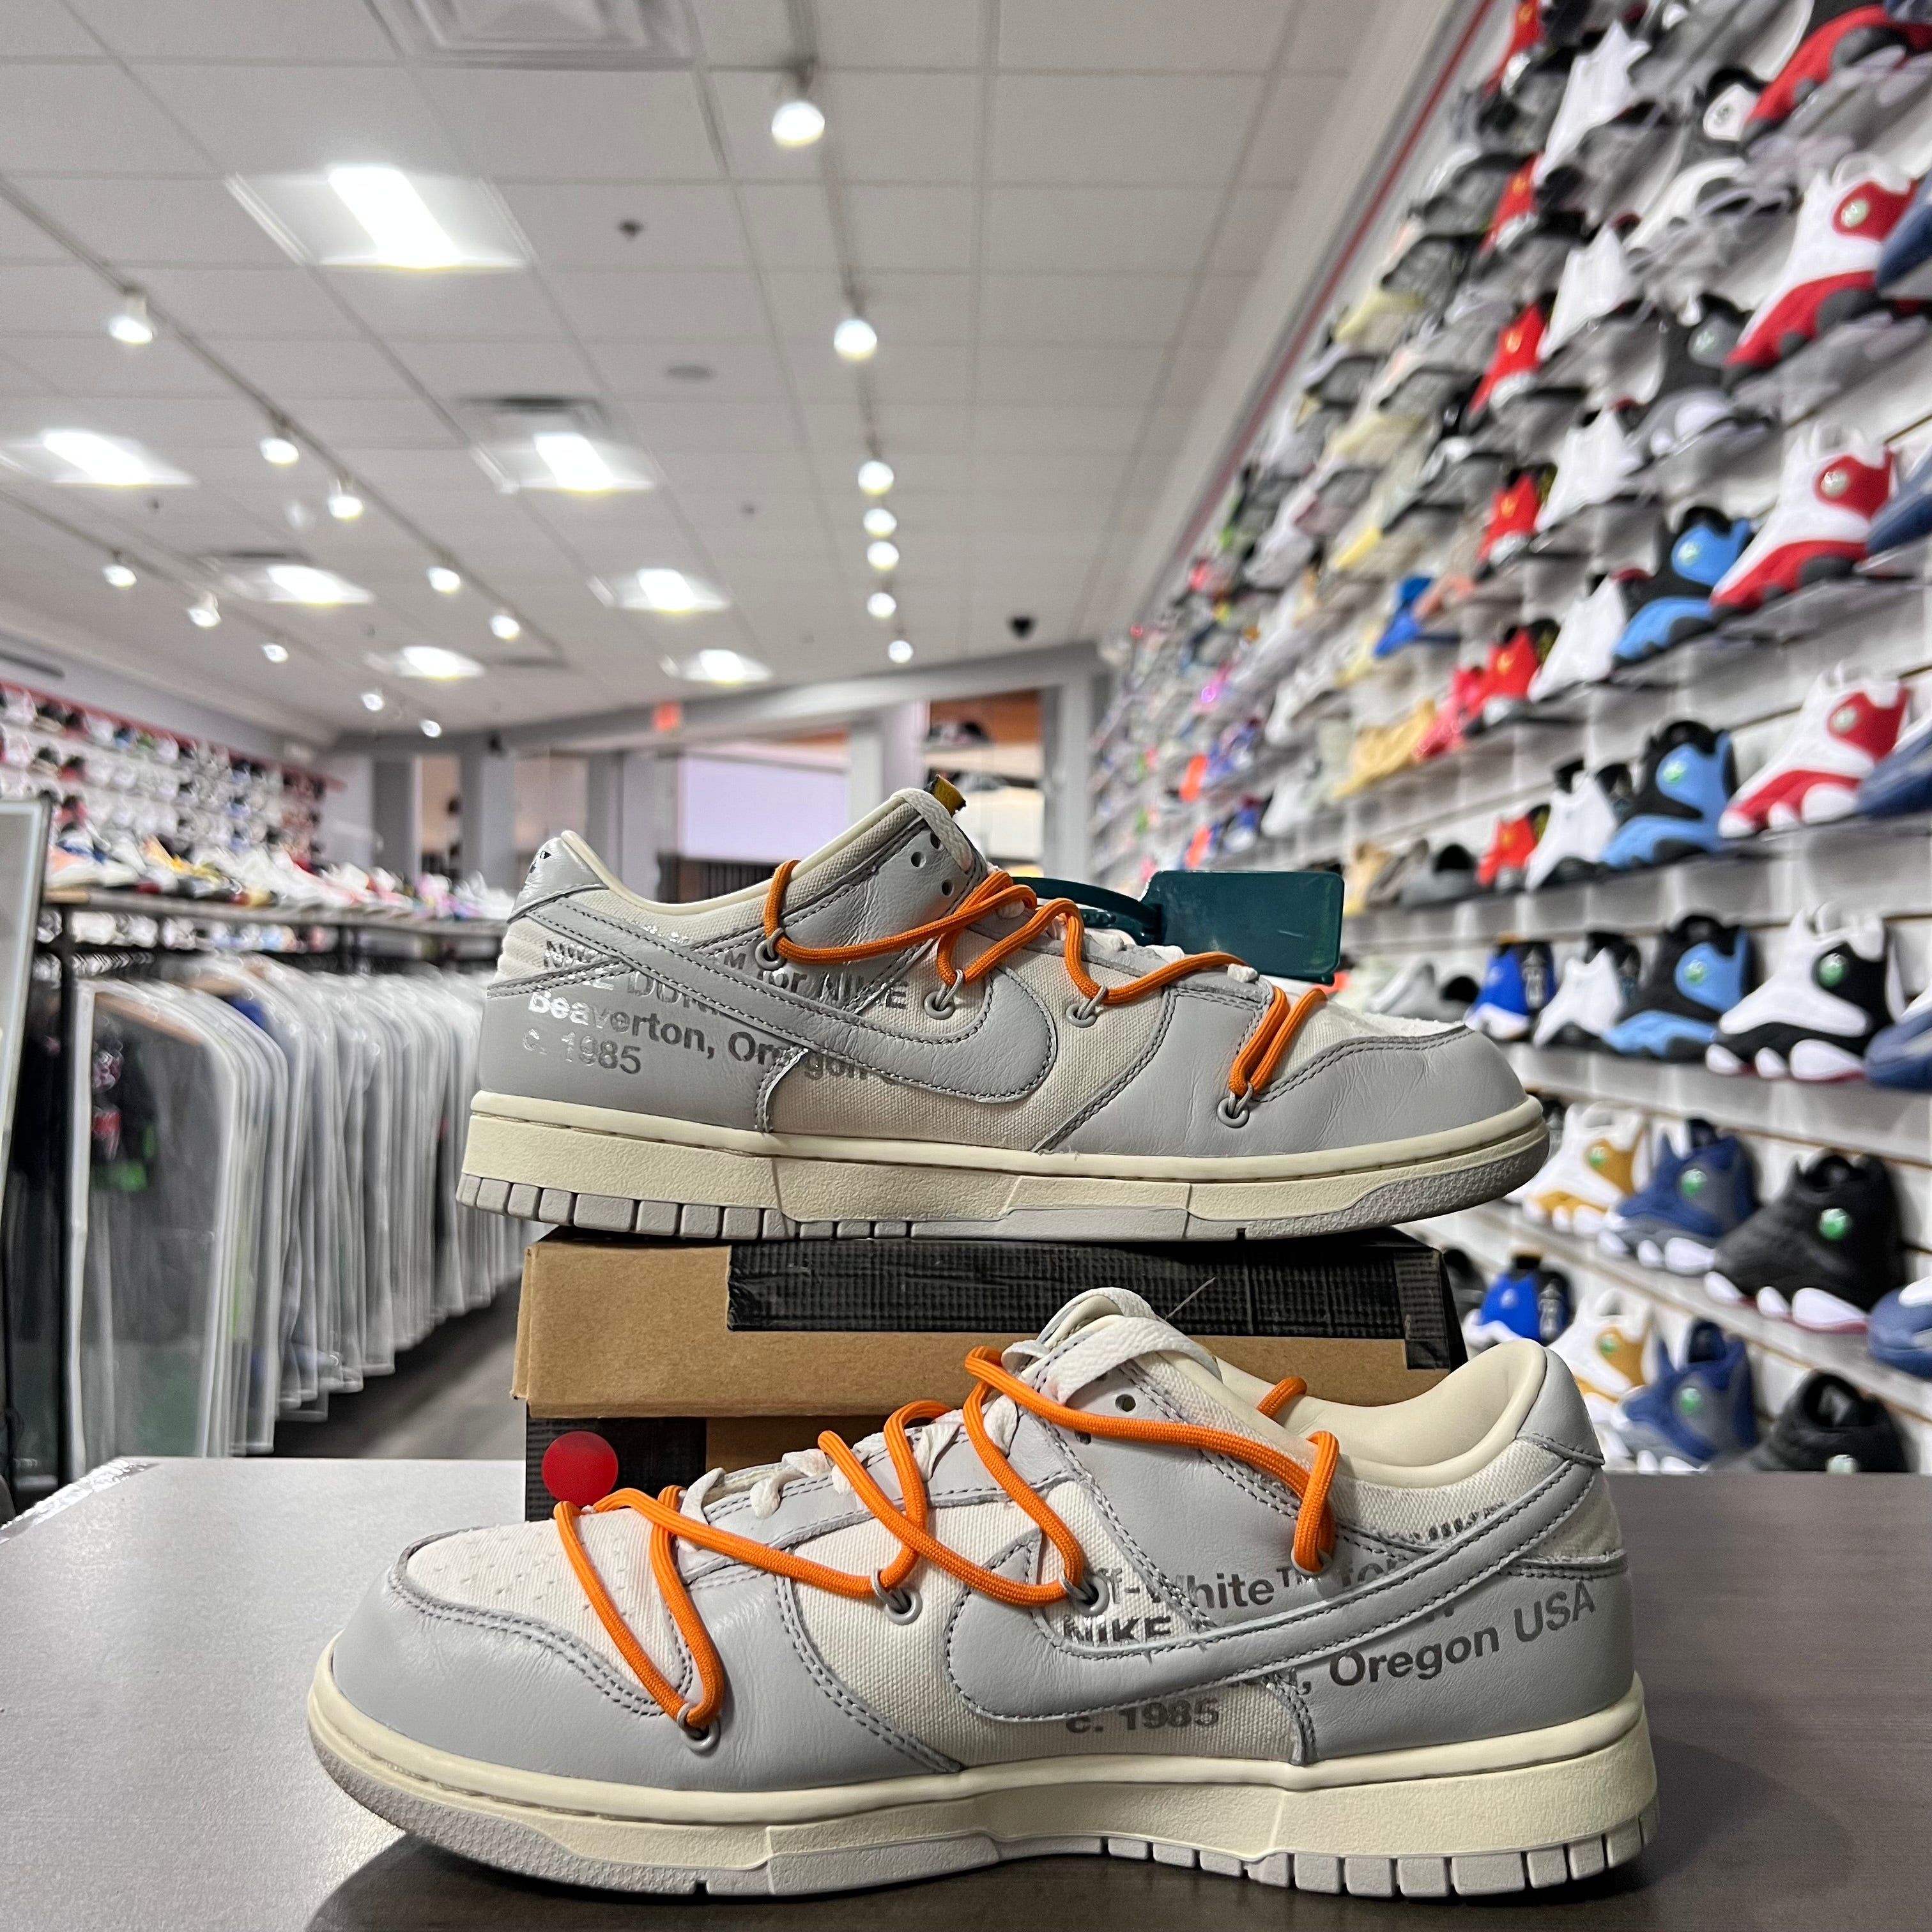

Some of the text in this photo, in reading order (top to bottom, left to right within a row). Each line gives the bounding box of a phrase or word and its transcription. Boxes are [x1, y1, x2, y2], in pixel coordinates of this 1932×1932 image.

[528, 990, 716, 1060] Beaverton,
[561, 1031, 642, 1075] 1985
[1329, 1626, 1499, 1687] Oregon
[1514, 1579, 1596, 1643] USA
[1065, 1697, 1220, 1733] c. 1985
